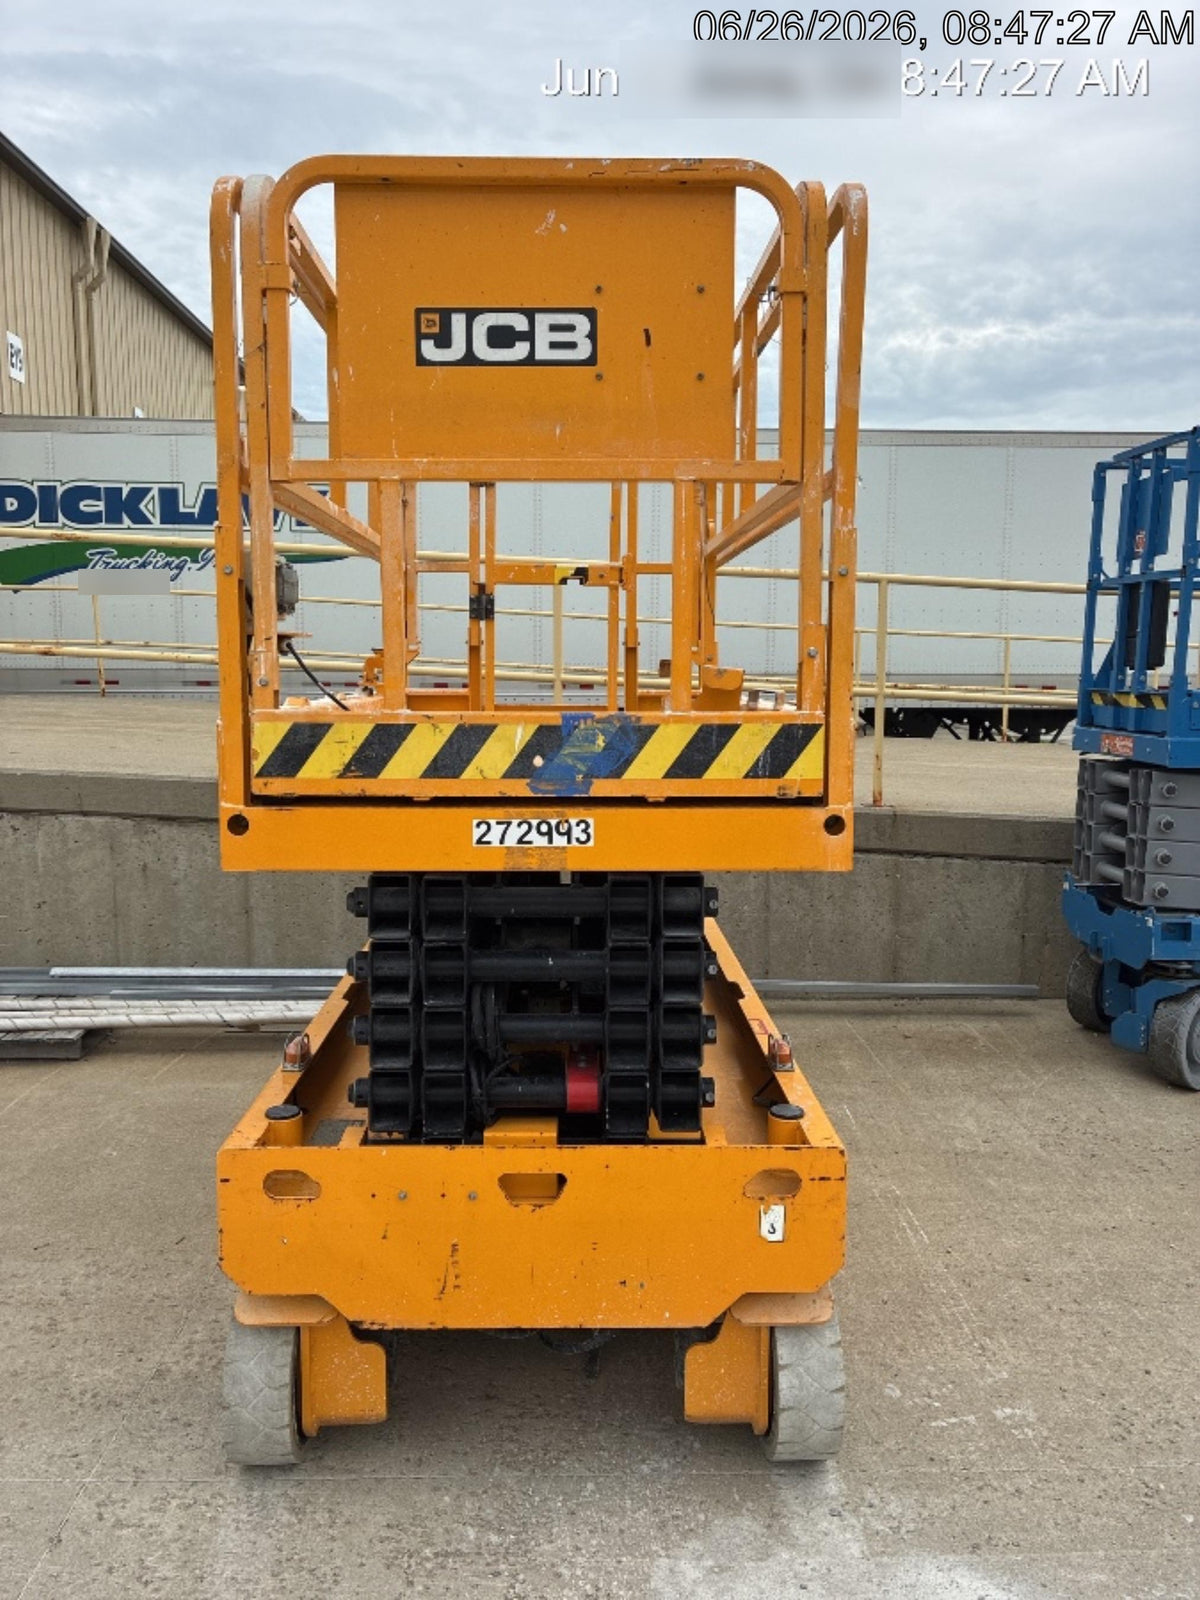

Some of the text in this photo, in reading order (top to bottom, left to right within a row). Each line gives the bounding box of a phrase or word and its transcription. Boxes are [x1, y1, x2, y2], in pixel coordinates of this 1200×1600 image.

[420, 312, 592, 361] JCB
[0, 484, 155, 526] DICK
[474, 819, 592, 845] 272993
